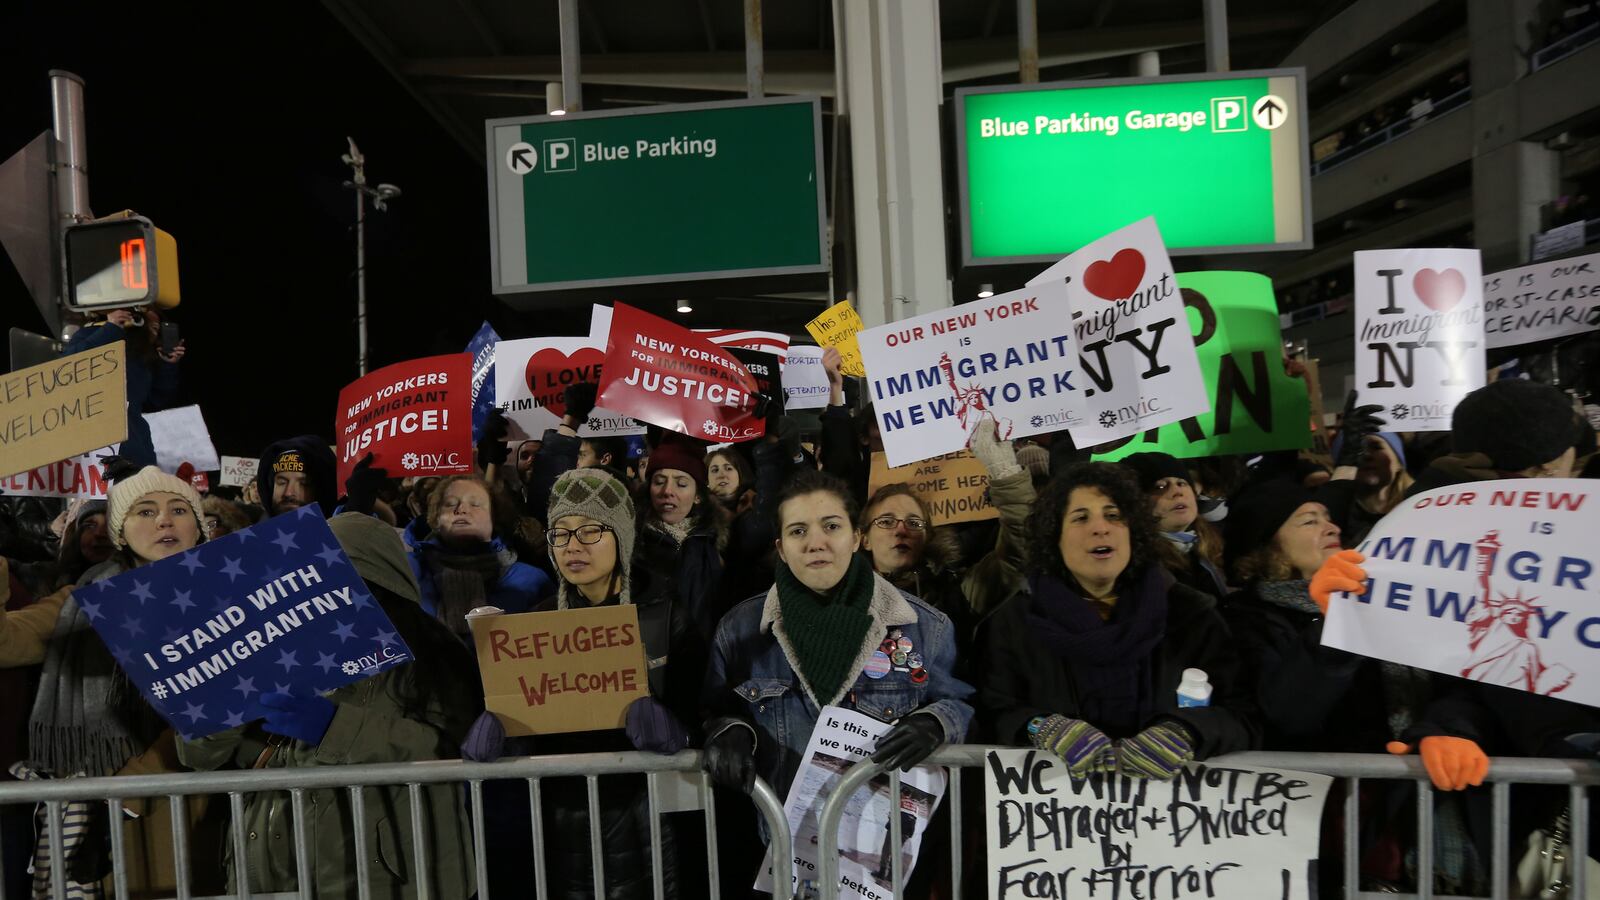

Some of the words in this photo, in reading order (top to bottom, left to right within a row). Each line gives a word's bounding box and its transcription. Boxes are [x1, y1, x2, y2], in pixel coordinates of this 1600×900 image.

[981, 117, 1029, 138] Blue
[1035, 111, 1119, 136] Parking
[1125, 108, 1207, 132] Garage
[1217, 101, 1240, 128] P
[549, 142, 570, 169] P
[583, 142, 629, 162] Blue
[636, 135, 717, 158] Parking
[120, 238, 148, 289] 10
[1518, 273, 1535, 287] IS
[1551, 262, 1596, 278] OUR
[1074, 272, 1174, 340] migrant
[1376, 268, 1405, 315] I
[1485, 284, 1600, 313] ORST-CASE
[886, 327, 925, 347] OUR
[931, 312, 977, 336] NEW
[984, 297, 1040, 322] YORK
[1360, 302, 1480, 348] Immigrant
[1484, 305, 1600, 334] CENARIO
[635, 333, 675, 354] NEW
[680, 346, 745, 377] YORKERS
[960, 336, 972, 347] IS
[472, 343, 492, 372] WITH
[631, 350, 654, 364] FOR
[874, 335, 1069, 400] IMMIGRANT
[1080, 317, 1176, 398] NY
[1367, 341, 1478, 388] NY
[0, 349, 119, 404] EFUGEES
[531, 375, 537, 390] I
[547, 363, 603, 387] LOVE
[624, 367, 750, 411] JUSTICE!
[347, 395, 372, 419] NEW
[376, 372, 448, 402] YORKERS
[501, 393, 566, 412] #IMMIG
[882, 395, 955, 432] NEW
[982, 370, 1077, 407] YORK
[1118, 397, 1160, 423] nyic
[344, 421, 358, 436] FOR
[358, 391, 448, 427] IMMIGRANT
[602, 414, 634, 433] nyic
[1043, 407, 1075, 427] nyic
[343, 409, 448, 463] JUSTICE!
[421, 449, 459, 472] nyic
[914, 465, 941, 477] ARE
[957, 475, 991, 489] HER
[1413, 491, 1478, 509] OUR
[1488, 491, 1587, 512] NEW
[1529, 521, 1555, 535] IS
[143, 652, 159, 670] I
[161, 605, 246, 663] STAND
[246, 564, 323, 611] WITH
[1532, 605, 1600, 649] YO
[151, 586, 355, 699] #IMMIGRANTNY
[357, 646, 396, 673] nyic
[826, 717, 839, 728] Is
[843, 720, 869, 738] this
[820, 737, 840, 749] we
[844, 743, 871, 758] wan
[793, 855, 815, 872] are
[841, 875, 882, 900] better
